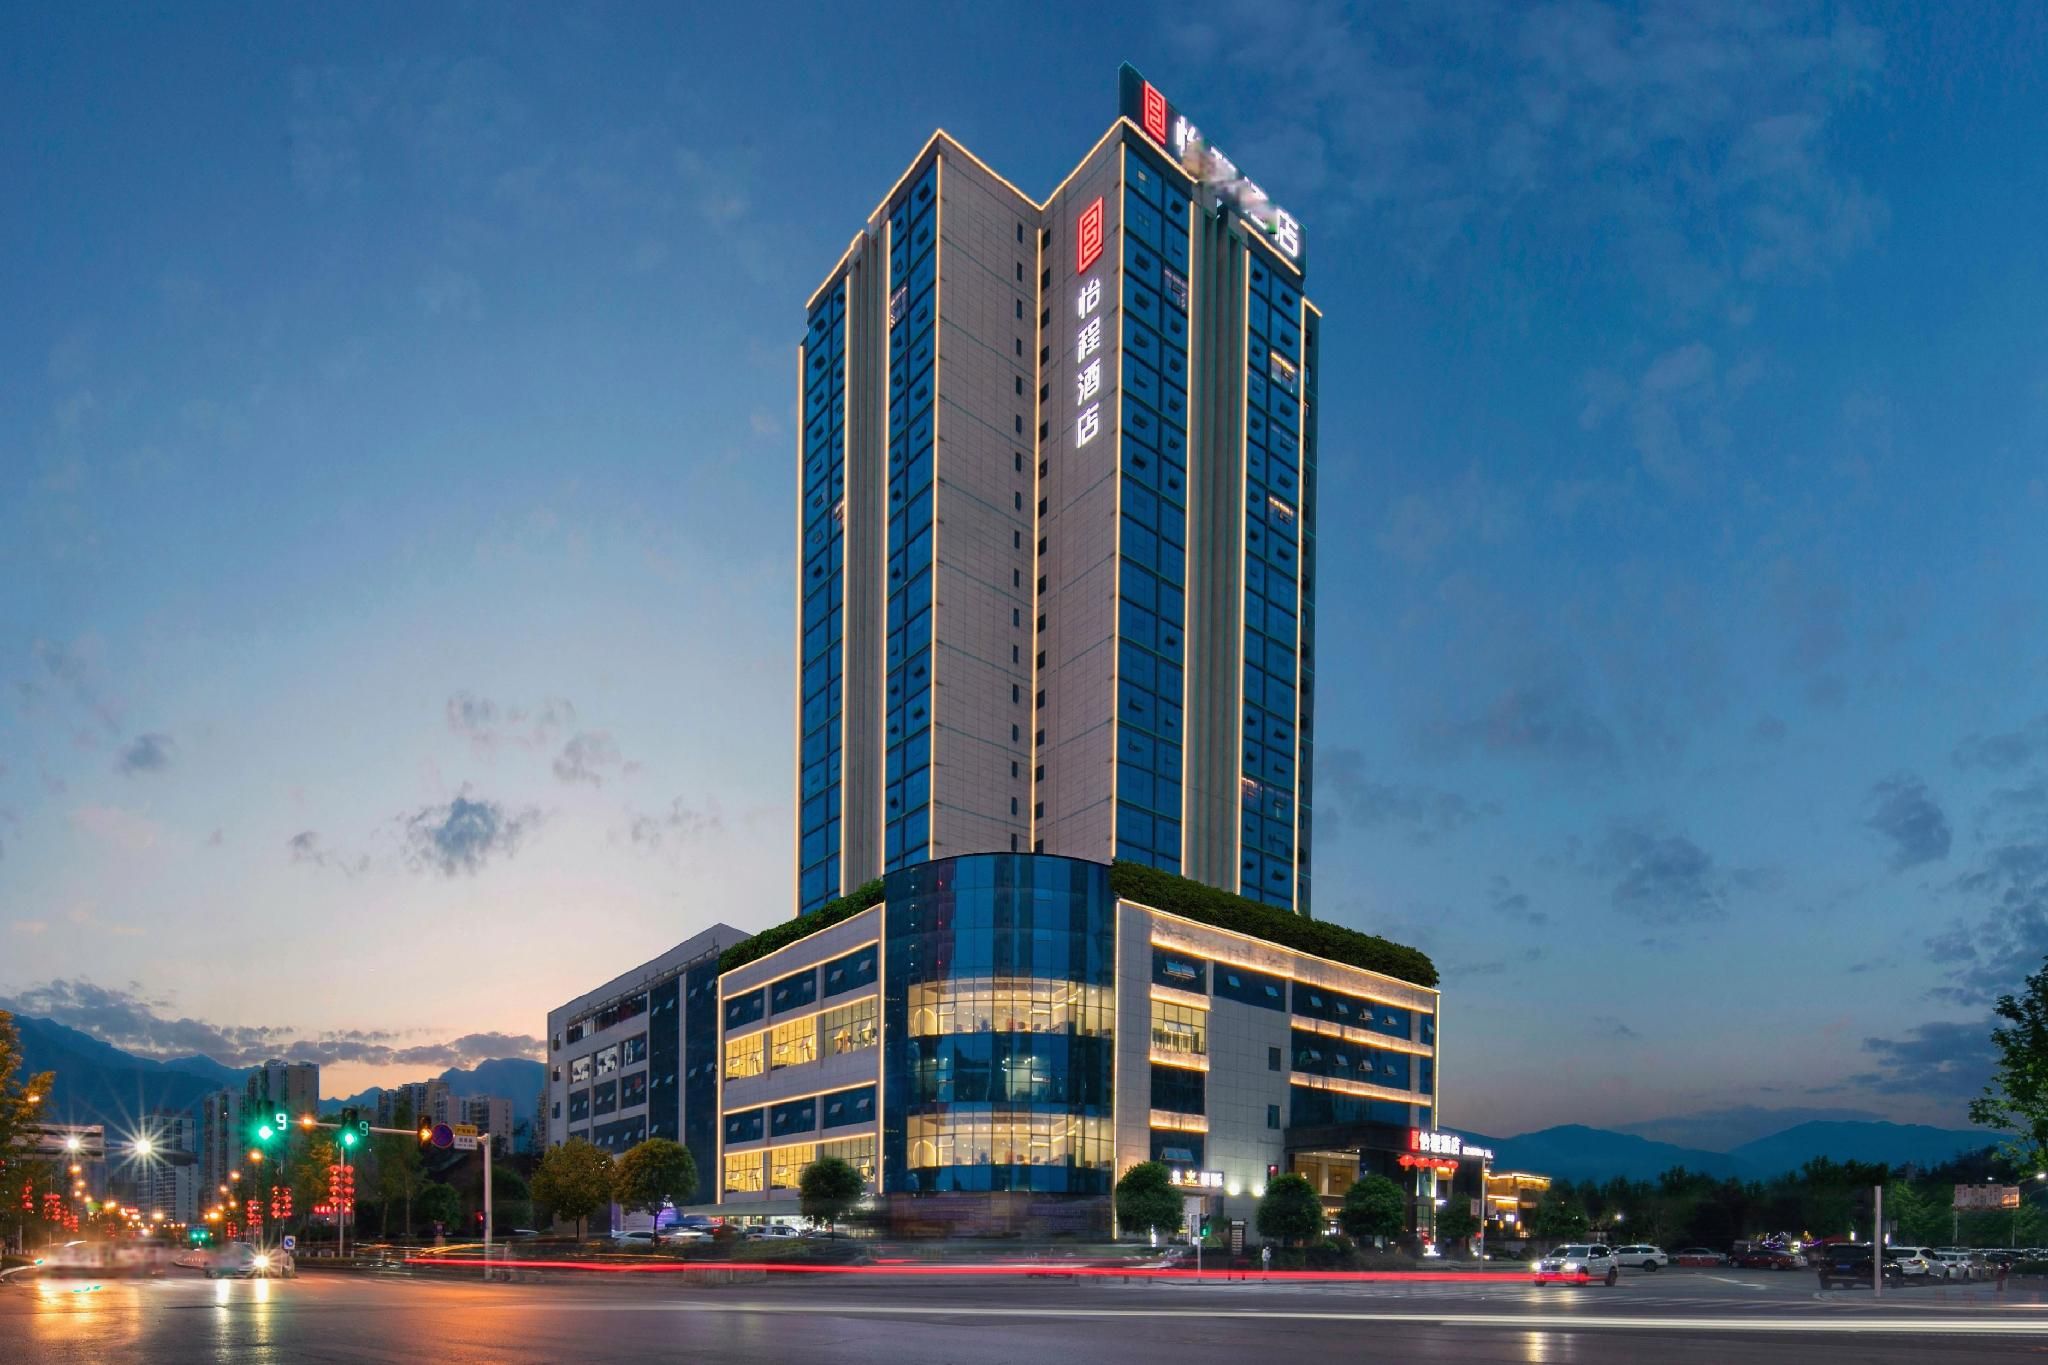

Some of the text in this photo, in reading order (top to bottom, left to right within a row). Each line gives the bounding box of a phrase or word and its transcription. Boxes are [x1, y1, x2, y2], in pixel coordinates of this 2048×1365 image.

[1076, 277, 1101, 449] 怡程酒店
[275, 1113, 287, 1131] 9
[359, 1120, 369, 1137] 9
